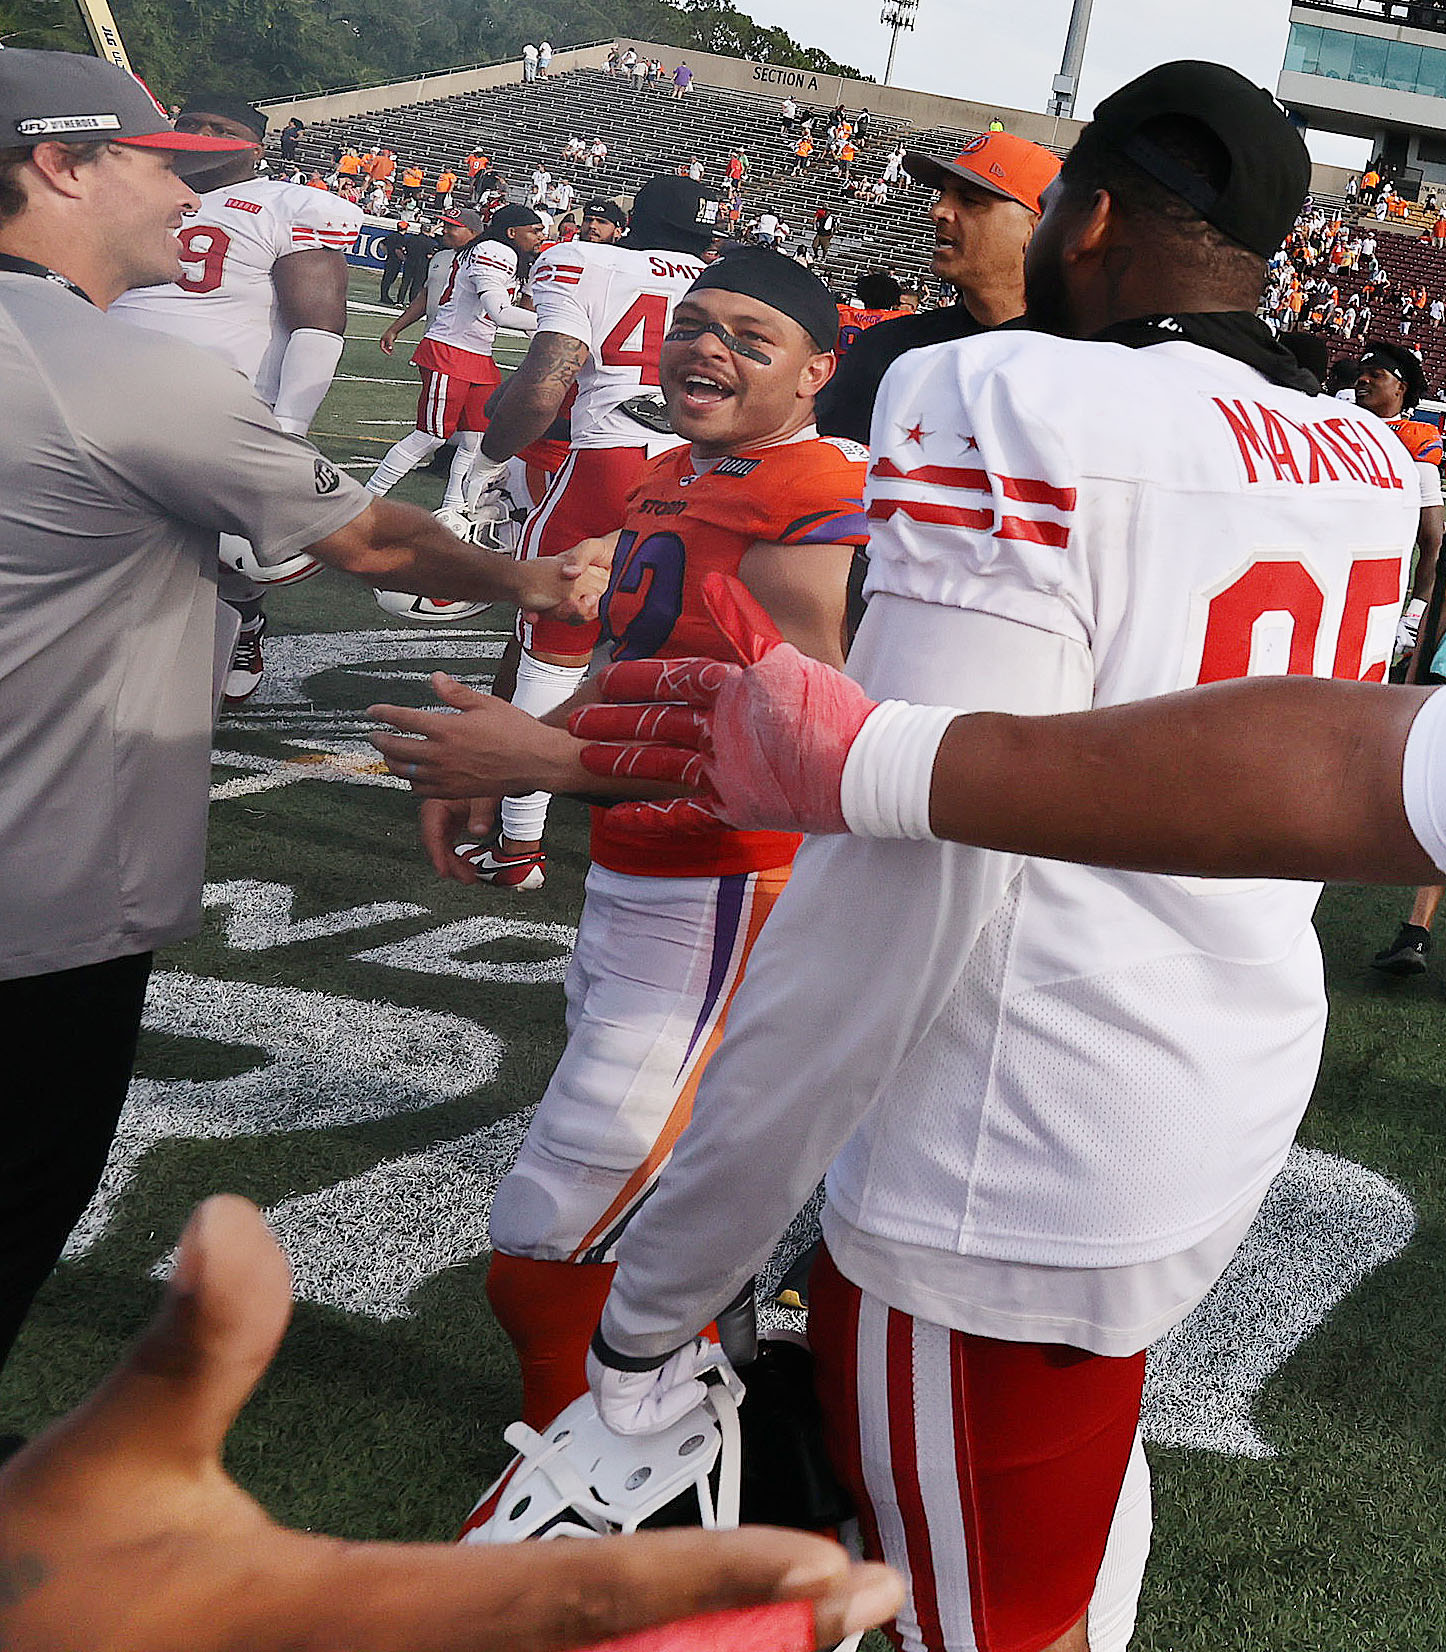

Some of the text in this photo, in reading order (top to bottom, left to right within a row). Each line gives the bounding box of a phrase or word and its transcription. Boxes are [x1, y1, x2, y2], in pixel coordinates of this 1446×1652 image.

[753, 66, 818, 91] SECTION A
[175, 225, 232, 295] 9
